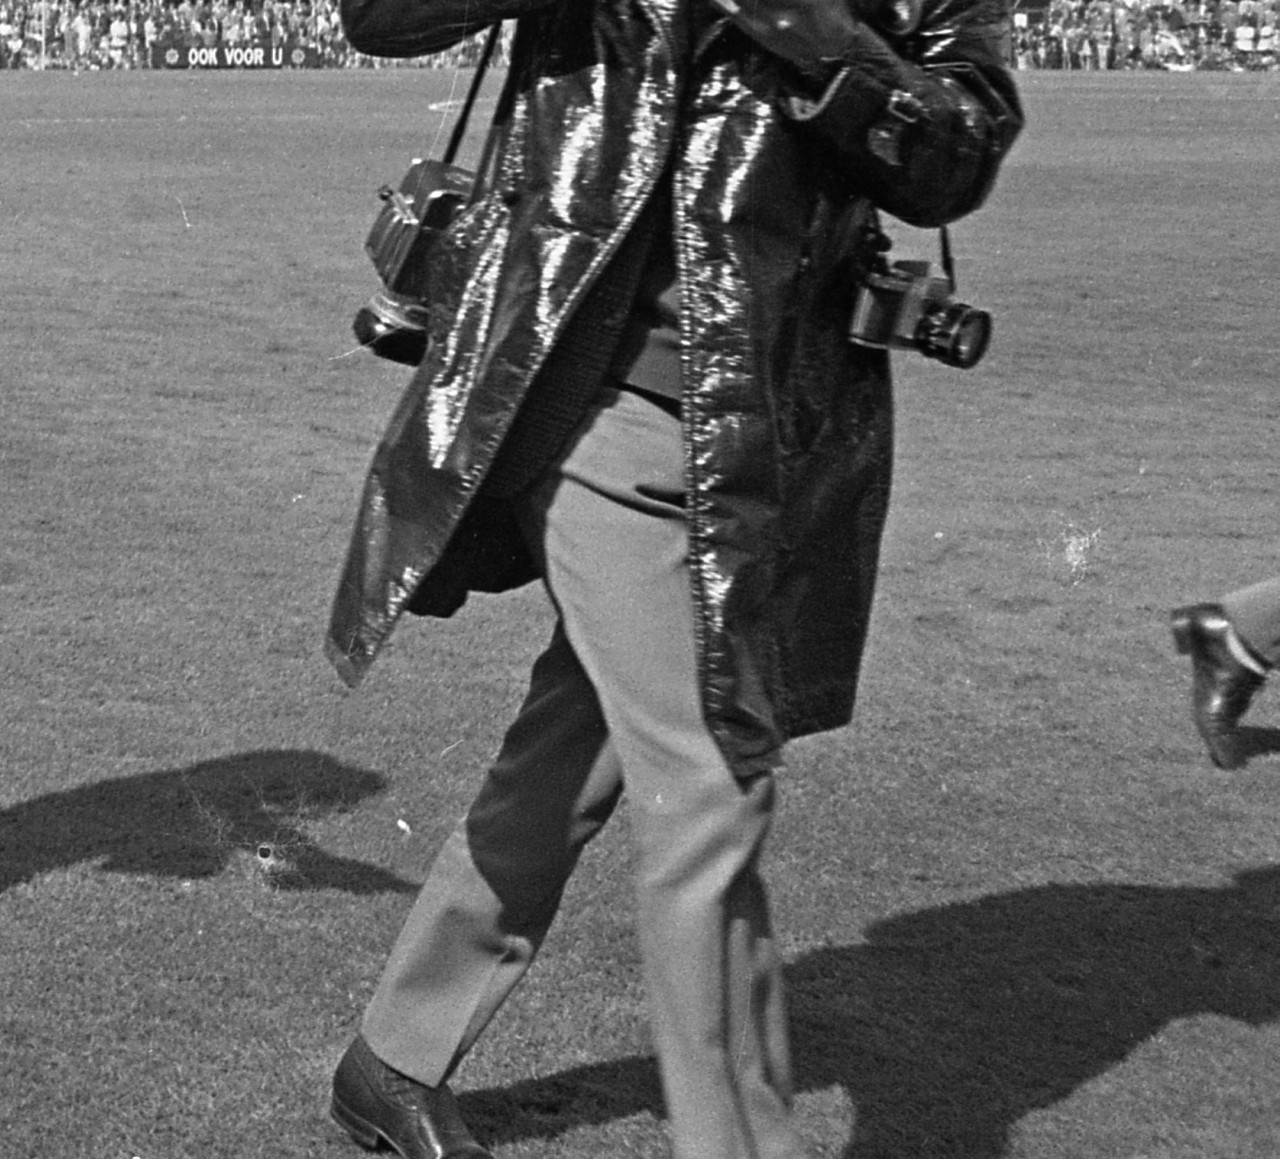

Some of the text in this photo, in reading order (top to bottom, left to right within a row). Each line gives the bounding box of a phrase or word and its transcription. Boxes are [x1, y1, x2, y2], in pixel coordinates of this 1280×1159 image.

[188, 48, 283, 66] OOK VOOR U
